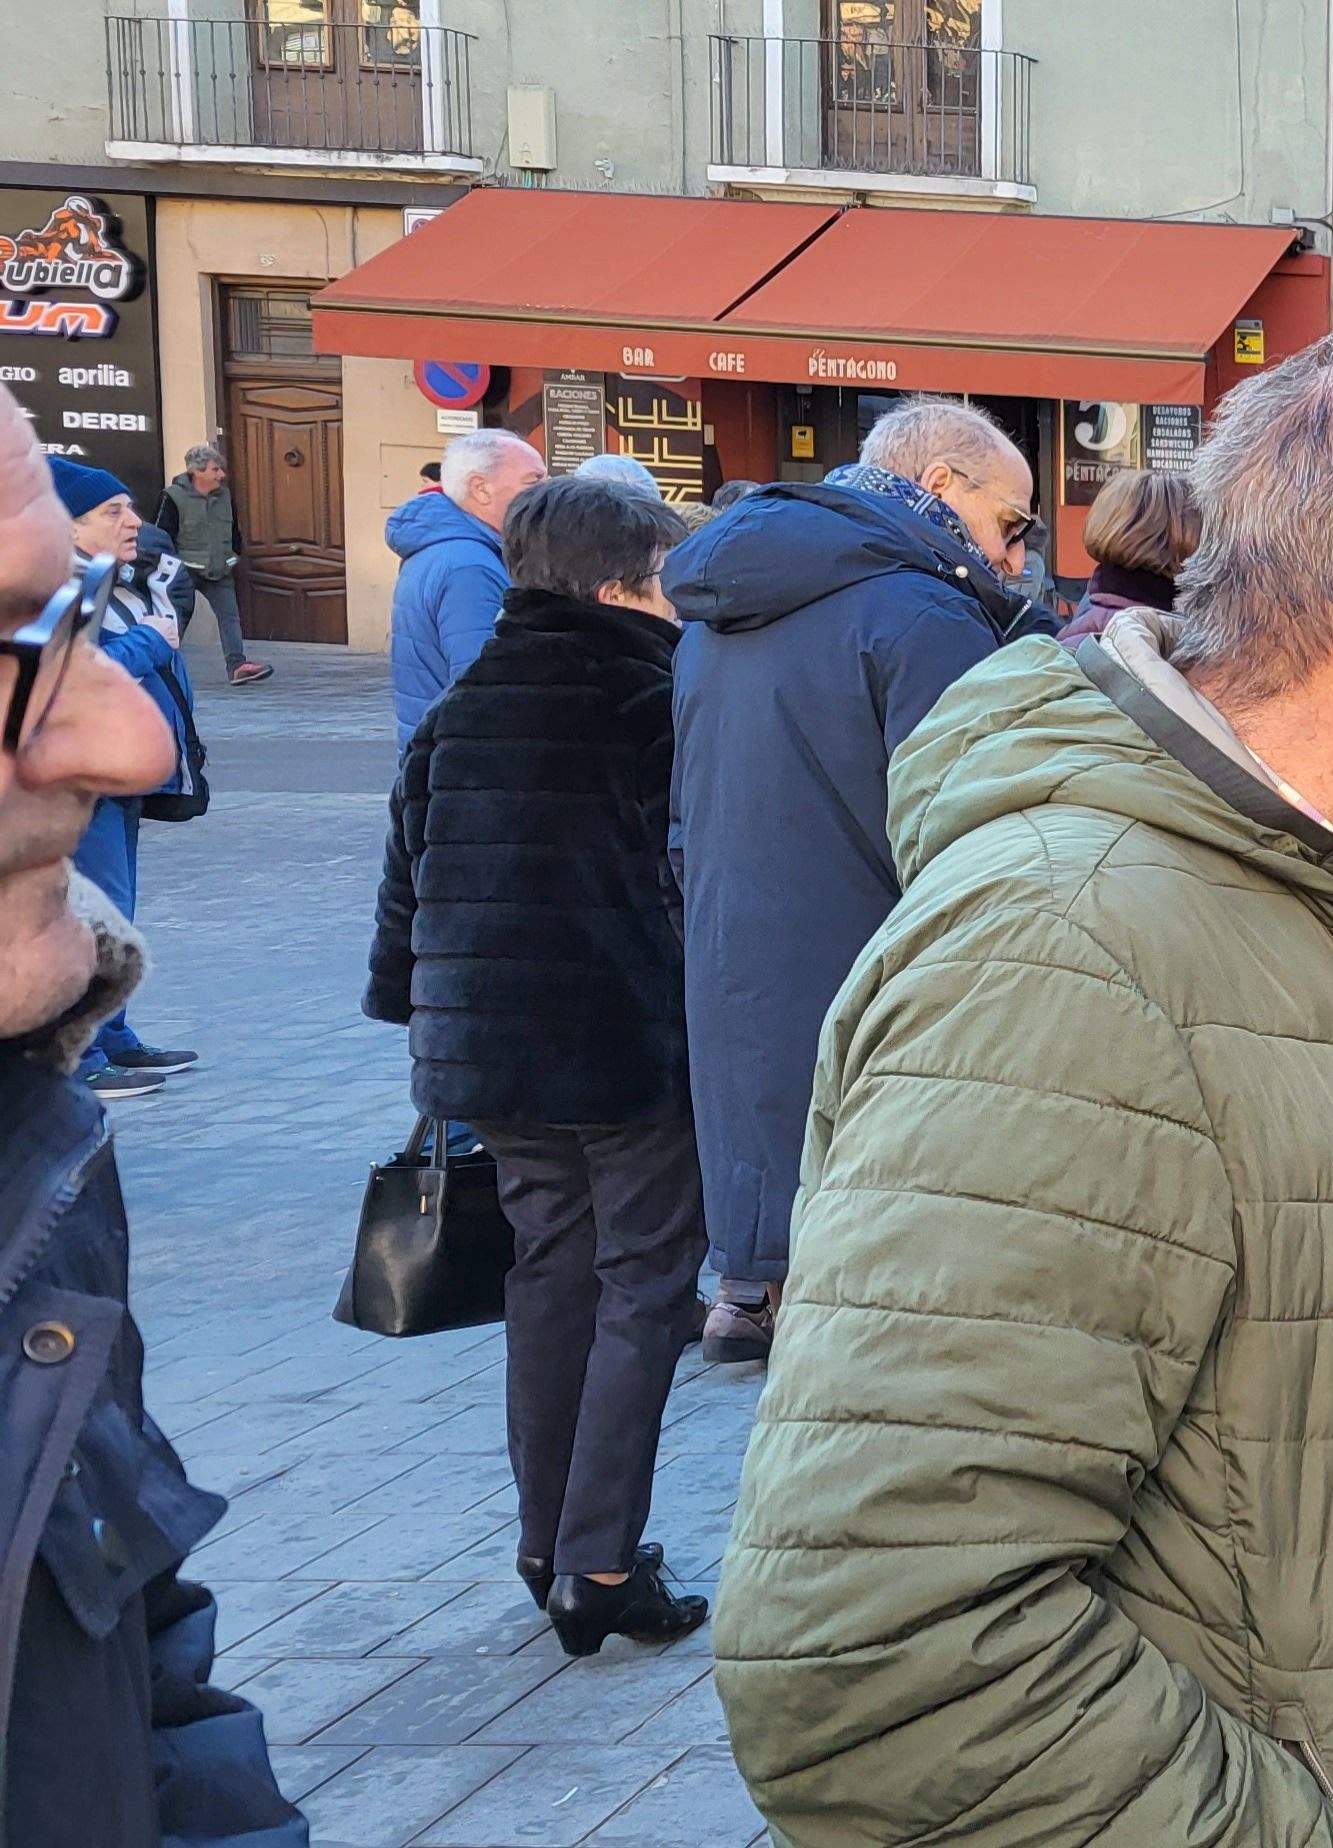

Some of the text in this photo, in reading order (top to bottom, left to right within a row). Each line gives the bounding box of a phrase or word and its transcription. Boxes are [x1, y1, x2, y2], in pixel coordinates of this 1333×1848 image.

[5, 259, 123, 289] ubiella
[622, 346, 655, 368] BAR
[708, 352, 746, 374] CAFE
[58, 363, 130, 388] aprilia
[549, 388, 598, 400] RACIONES
[62, 410, 147, 432] DERBI
